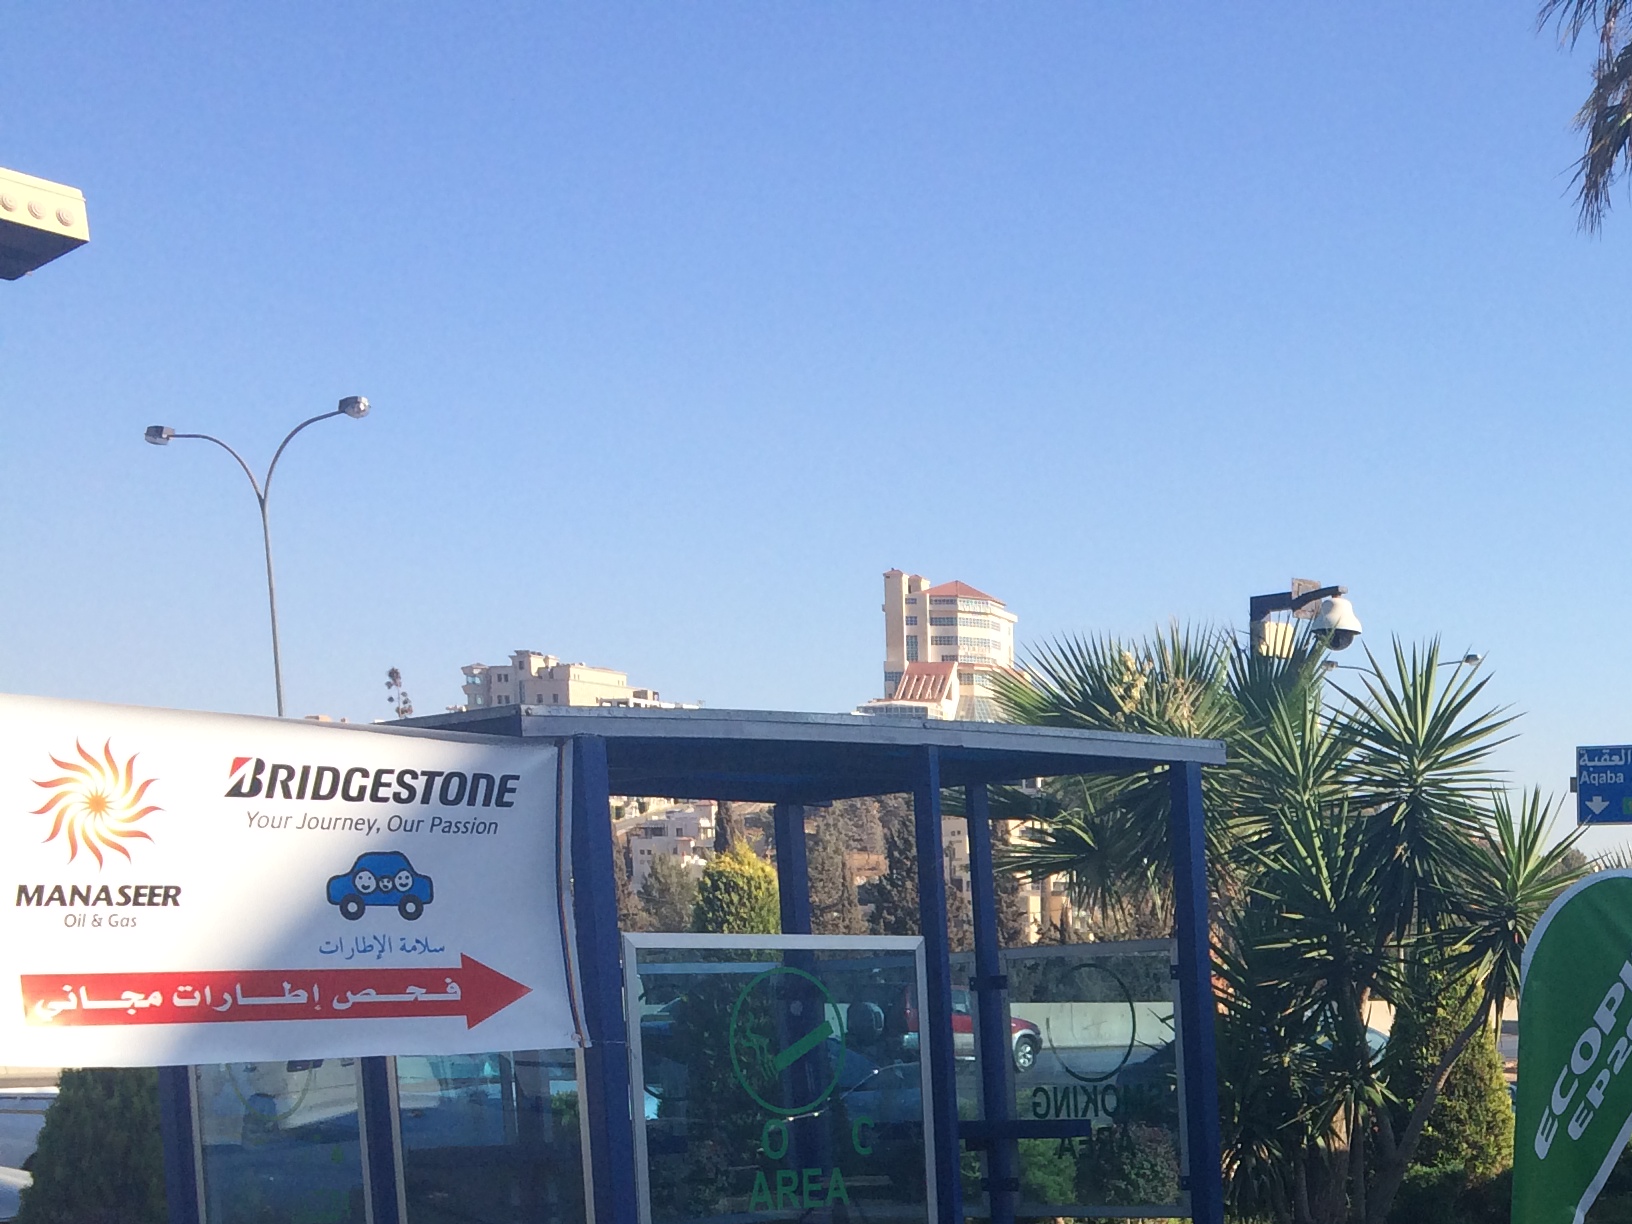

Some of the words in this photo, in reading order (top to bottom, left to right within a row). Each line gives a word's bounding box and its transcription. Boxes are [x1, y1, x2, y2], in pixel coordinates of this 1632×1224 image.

[1579, 748, 1631, 771] العقبة
[224, 756, 520, 808] BRIDGESTONE
[1579, 770, 1624, 786] Aqaba
[247, 811, 293, 829] Your
[296, 812, 381, 836] Journey,
[387, 815, 425, 833] Our
[429, 816, 499, 835] Passion
[16, 884, 182, 908] MANASEER
[64, 913, 87, 928] Oil
[91, 914, 103, 928] &
[108, 913, 138, 928] Gas
[318, 934, 393, 961] الإطارات
[399, 936, 446, 955] سلامة
[750, 1167, 850, 1212] AREA
